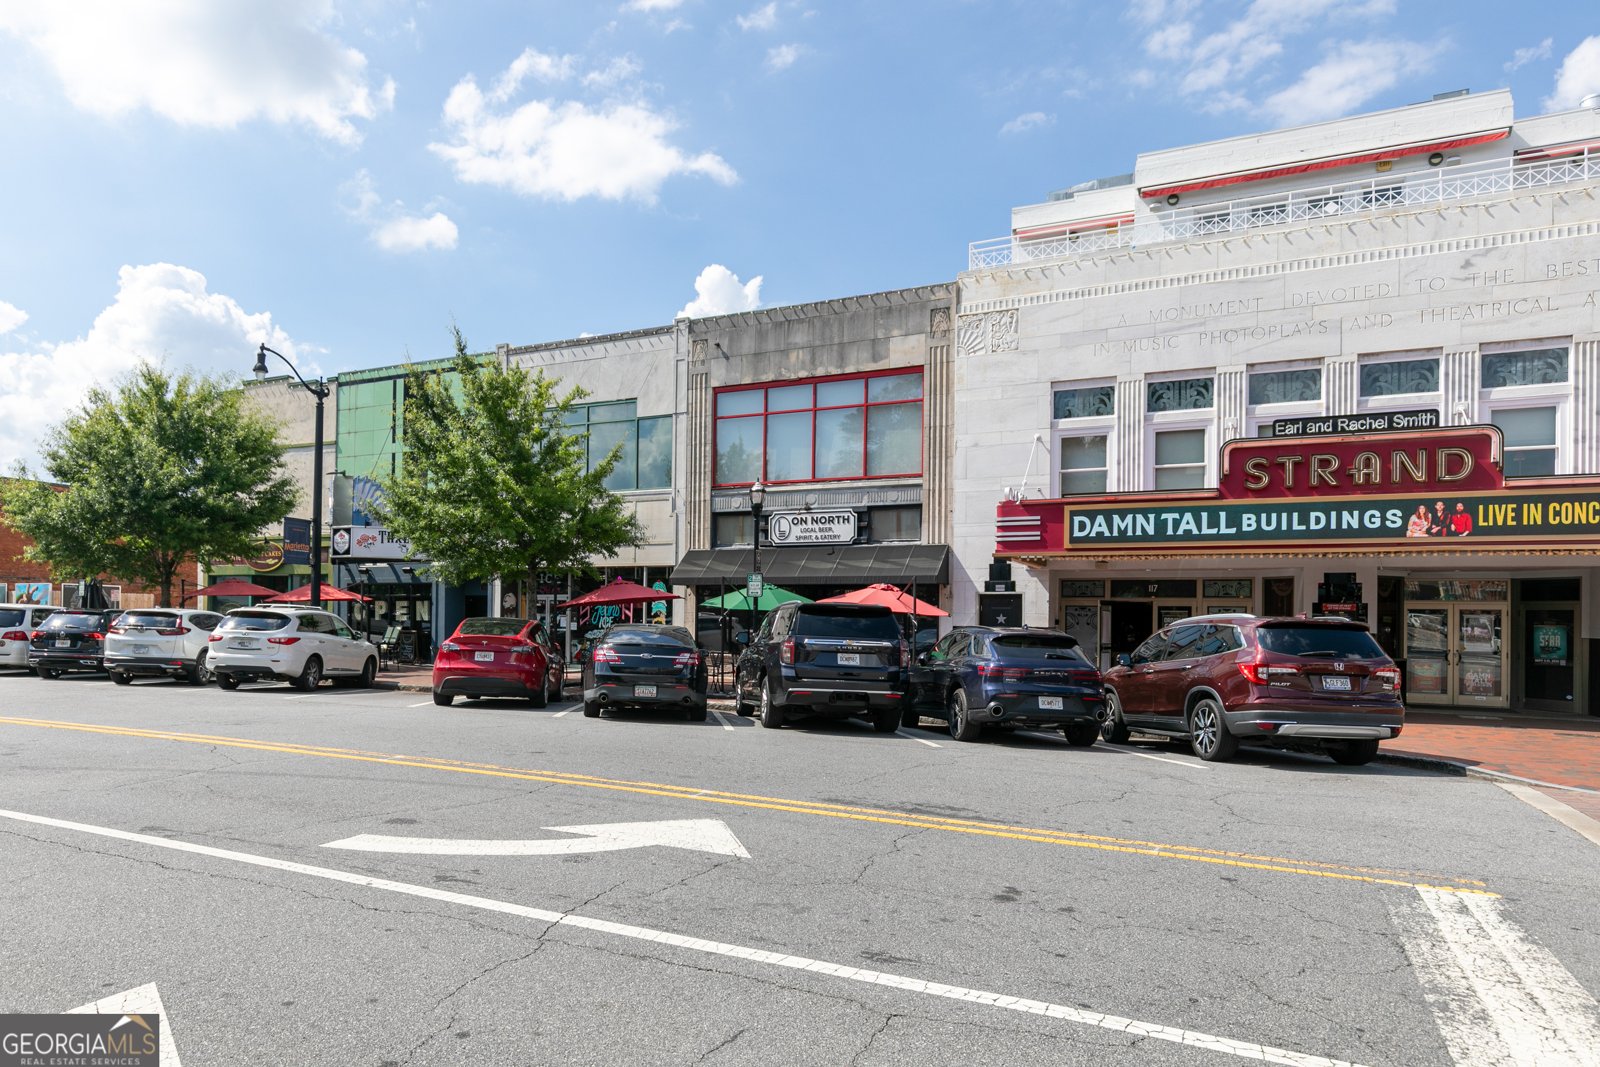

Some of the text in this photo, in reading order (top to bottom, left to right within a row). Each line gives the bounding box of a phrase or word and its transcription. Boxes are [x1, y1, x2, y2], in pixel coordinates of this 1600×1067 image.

[1118, 258, 1600, 327] A MONUMENT DEVOTED TO THE BEST
[1094, 343, 1110, 357] IN
[1123, 336, 1179, 353] MUSIC
[1199, 320, 1328, 346] PHOTOPLAYS
[1350, 313, 1393, 331] AND
[1419, 296, 1559, 324] THEATRICAL
[1275, 412, 1436, 435] Earl and Rachel Smith
[1244, 447, 1475, 490] STRAND
[791, 515, 850, 526] ON NORTH
[1072, 501, 1600, 538] DAMN TALL BUILDINGS LIVE IN CONC
[1148, 584, 1158, 592] 117
[354, 600, 429, 621] OPEN
